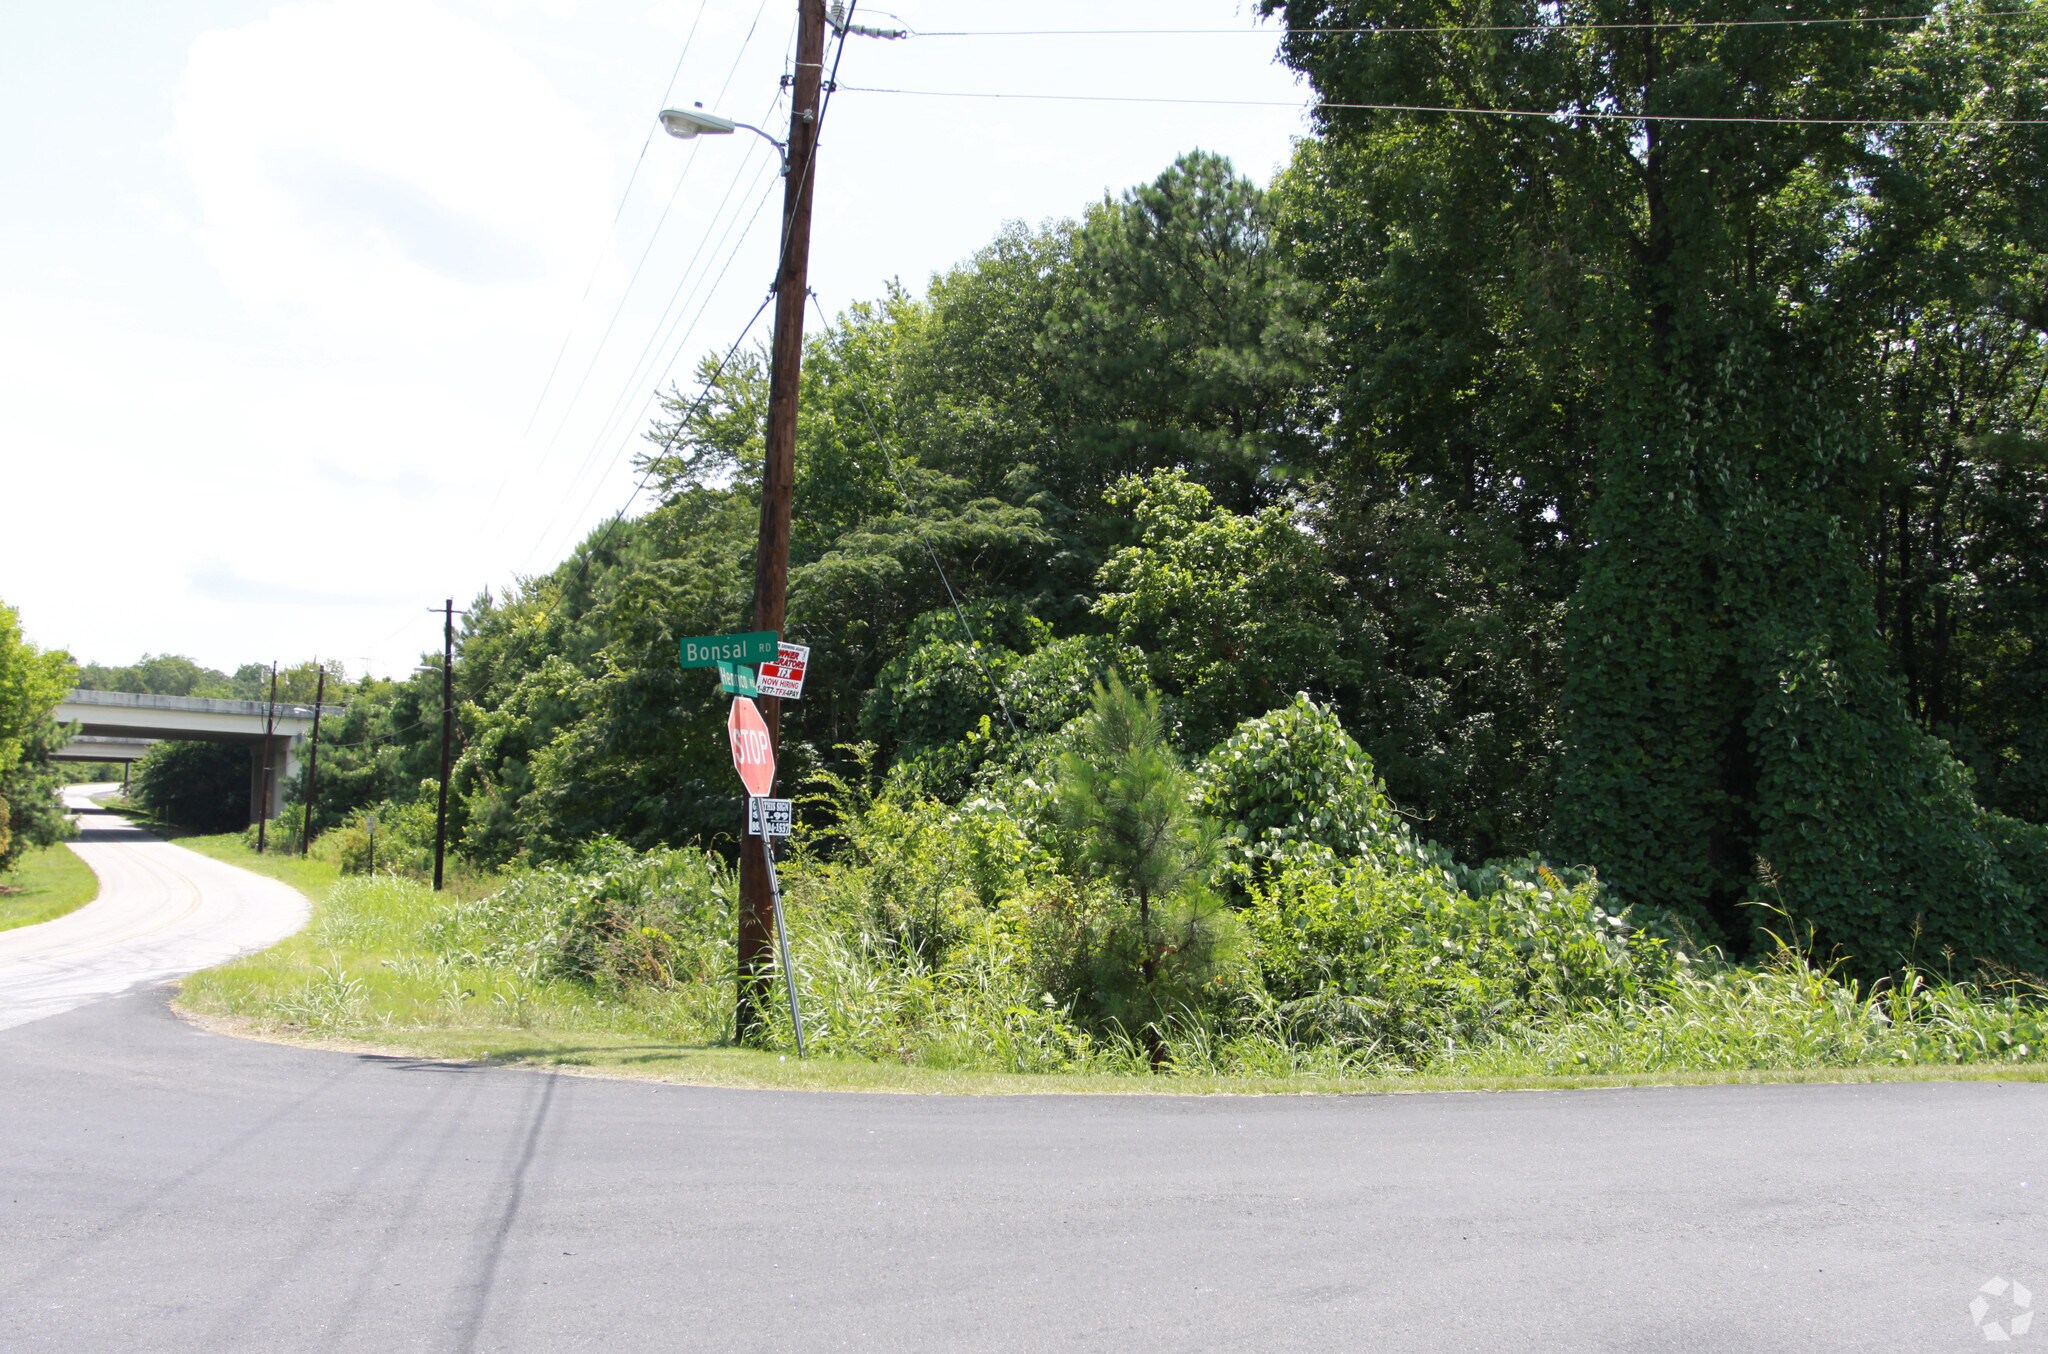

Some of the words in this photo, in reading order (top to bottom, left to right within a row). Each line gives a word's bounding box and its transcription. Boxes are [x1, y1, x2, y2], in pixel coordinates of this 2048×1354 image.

[687, 640, 747, 661] Bonsal
[759, 643, 771, 653] RD
[778, 649, 800, 660] WNER
[762, 677, 778, 687] NOW
[780, 679, 799, 690] HIRING
[733, 728, 768, 765] STOP
[764, 801, 776, 811] THIS
[777, 801, 789, 812] SIGN
